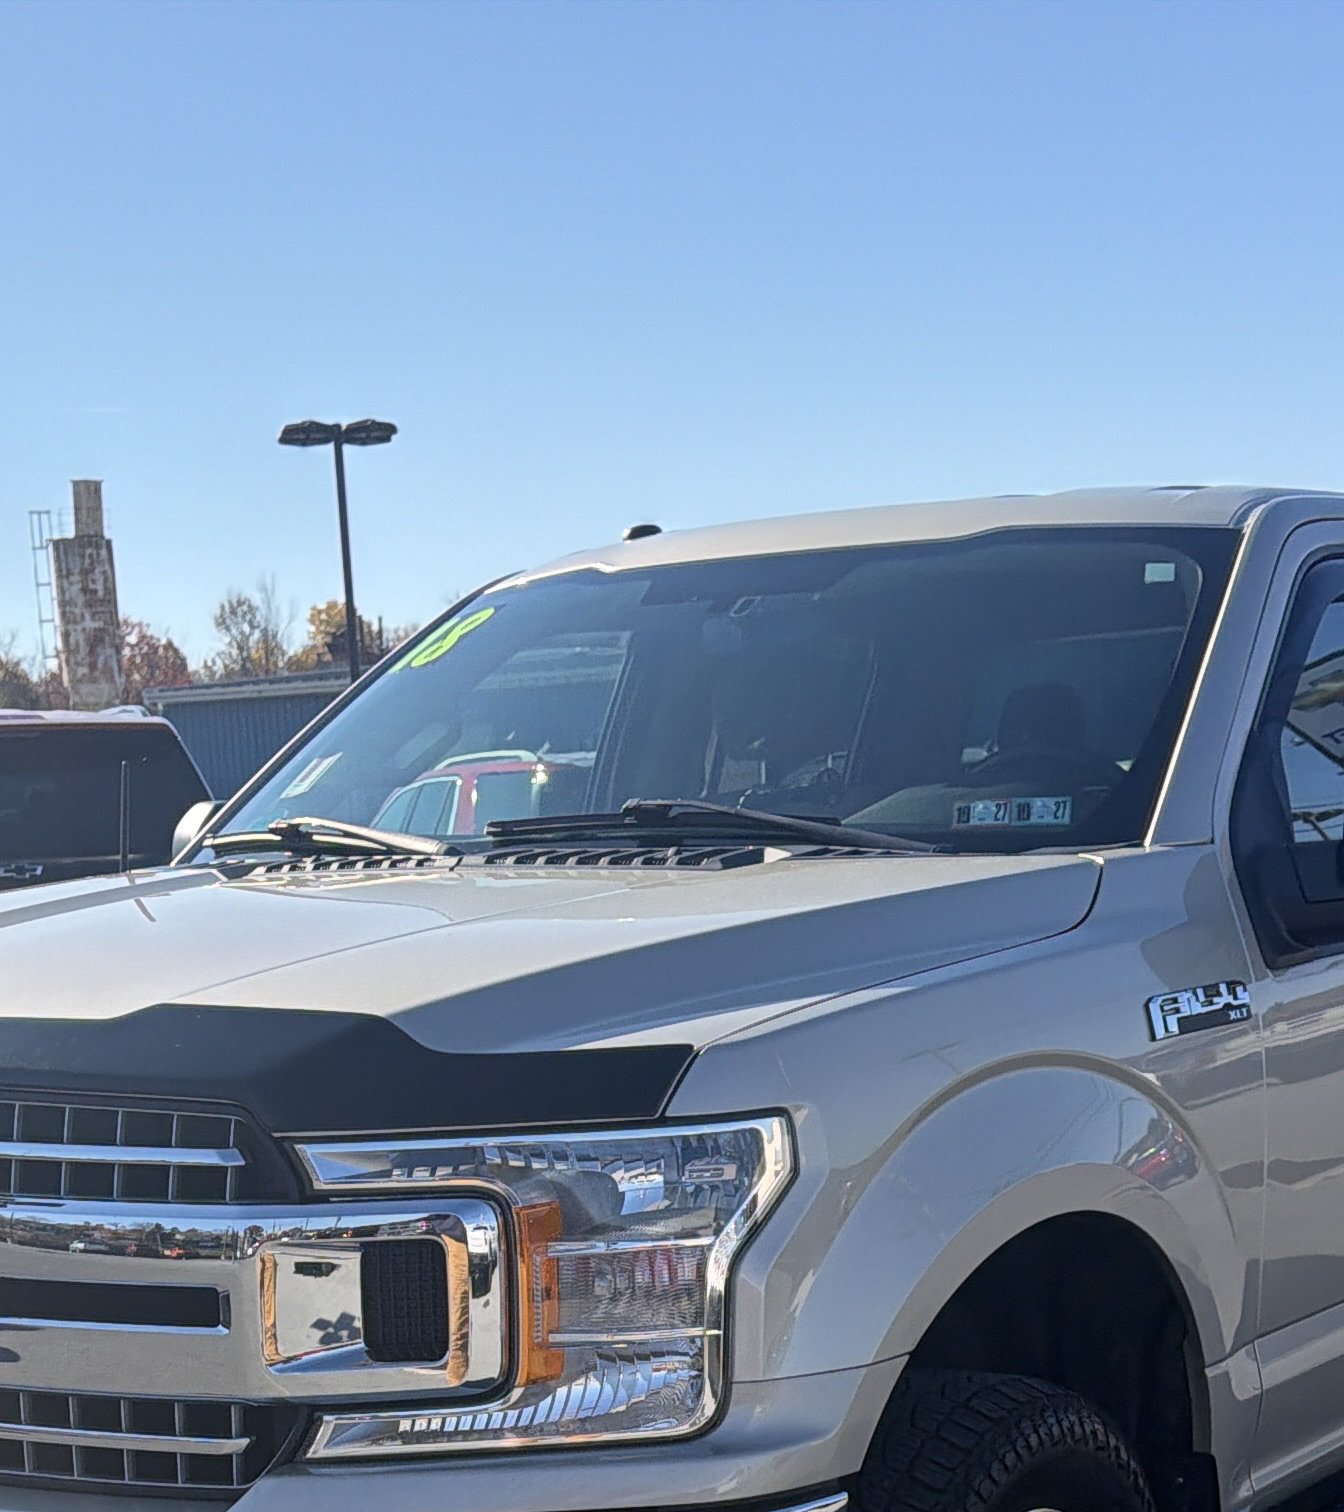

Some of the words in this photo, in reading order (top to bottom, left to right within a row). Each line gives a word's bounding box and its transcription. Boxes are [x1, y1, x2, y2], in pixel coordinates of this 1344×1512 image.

[388, 607, 495, 673] 18
[994, 802, 1008, 822] 27
[1053, 800, 1067, 820] 27
[1228, 1006, 1249, 1021] XLT
